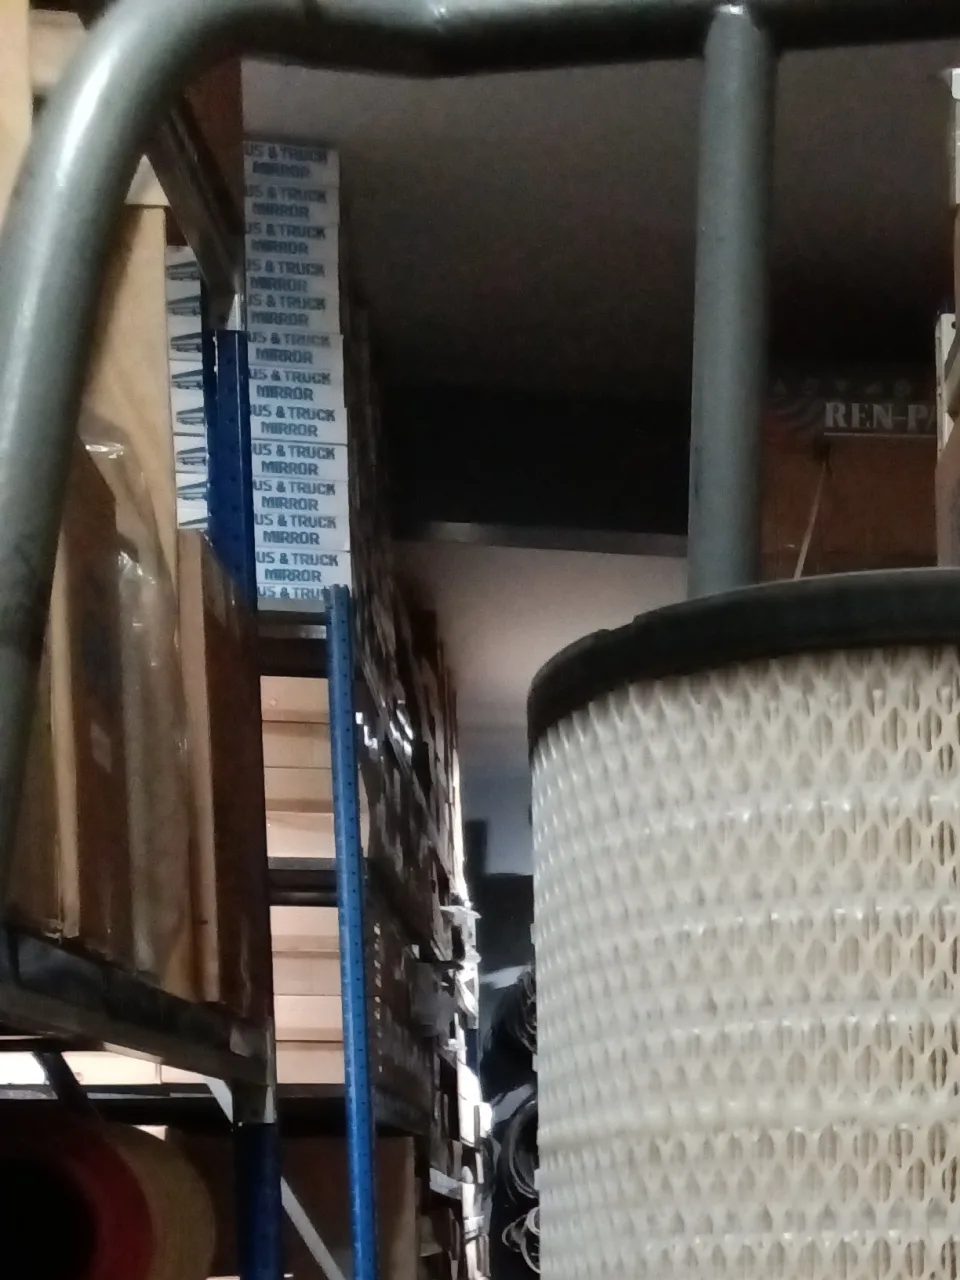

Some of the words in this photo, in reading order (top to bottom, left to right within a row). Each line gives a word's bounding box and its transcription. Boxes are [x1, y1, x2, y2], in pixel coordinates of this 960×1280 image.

[271, 369, 280, 381] &
[284, 370, 331, 385] TRUCK
[257, 385, 314, 401] MIRROR
[276, 406, 285, 419] &
[287, 406, 336, 422] TRUCK
[261, 421, 318, 437] MIRROR
[276, 444, 286, 457] &
[288, 445, 336, 460] TRUCK
[261, 460, 319, 476] MIRROR
[276, 481, 286, 493] &
[289, 481, 336, 496] TRUCK
[261, 495, 319, 511] MIRROR
[278, 514, 287, 527] &
[290, 515, 337, 529] TRUCK
[263, 531, 320, 545] MIRROR
[280, 553, 289, 565] &
[291, 553, 339, 567] TRUCK
[265, 568, 322, 583] MIRROR
